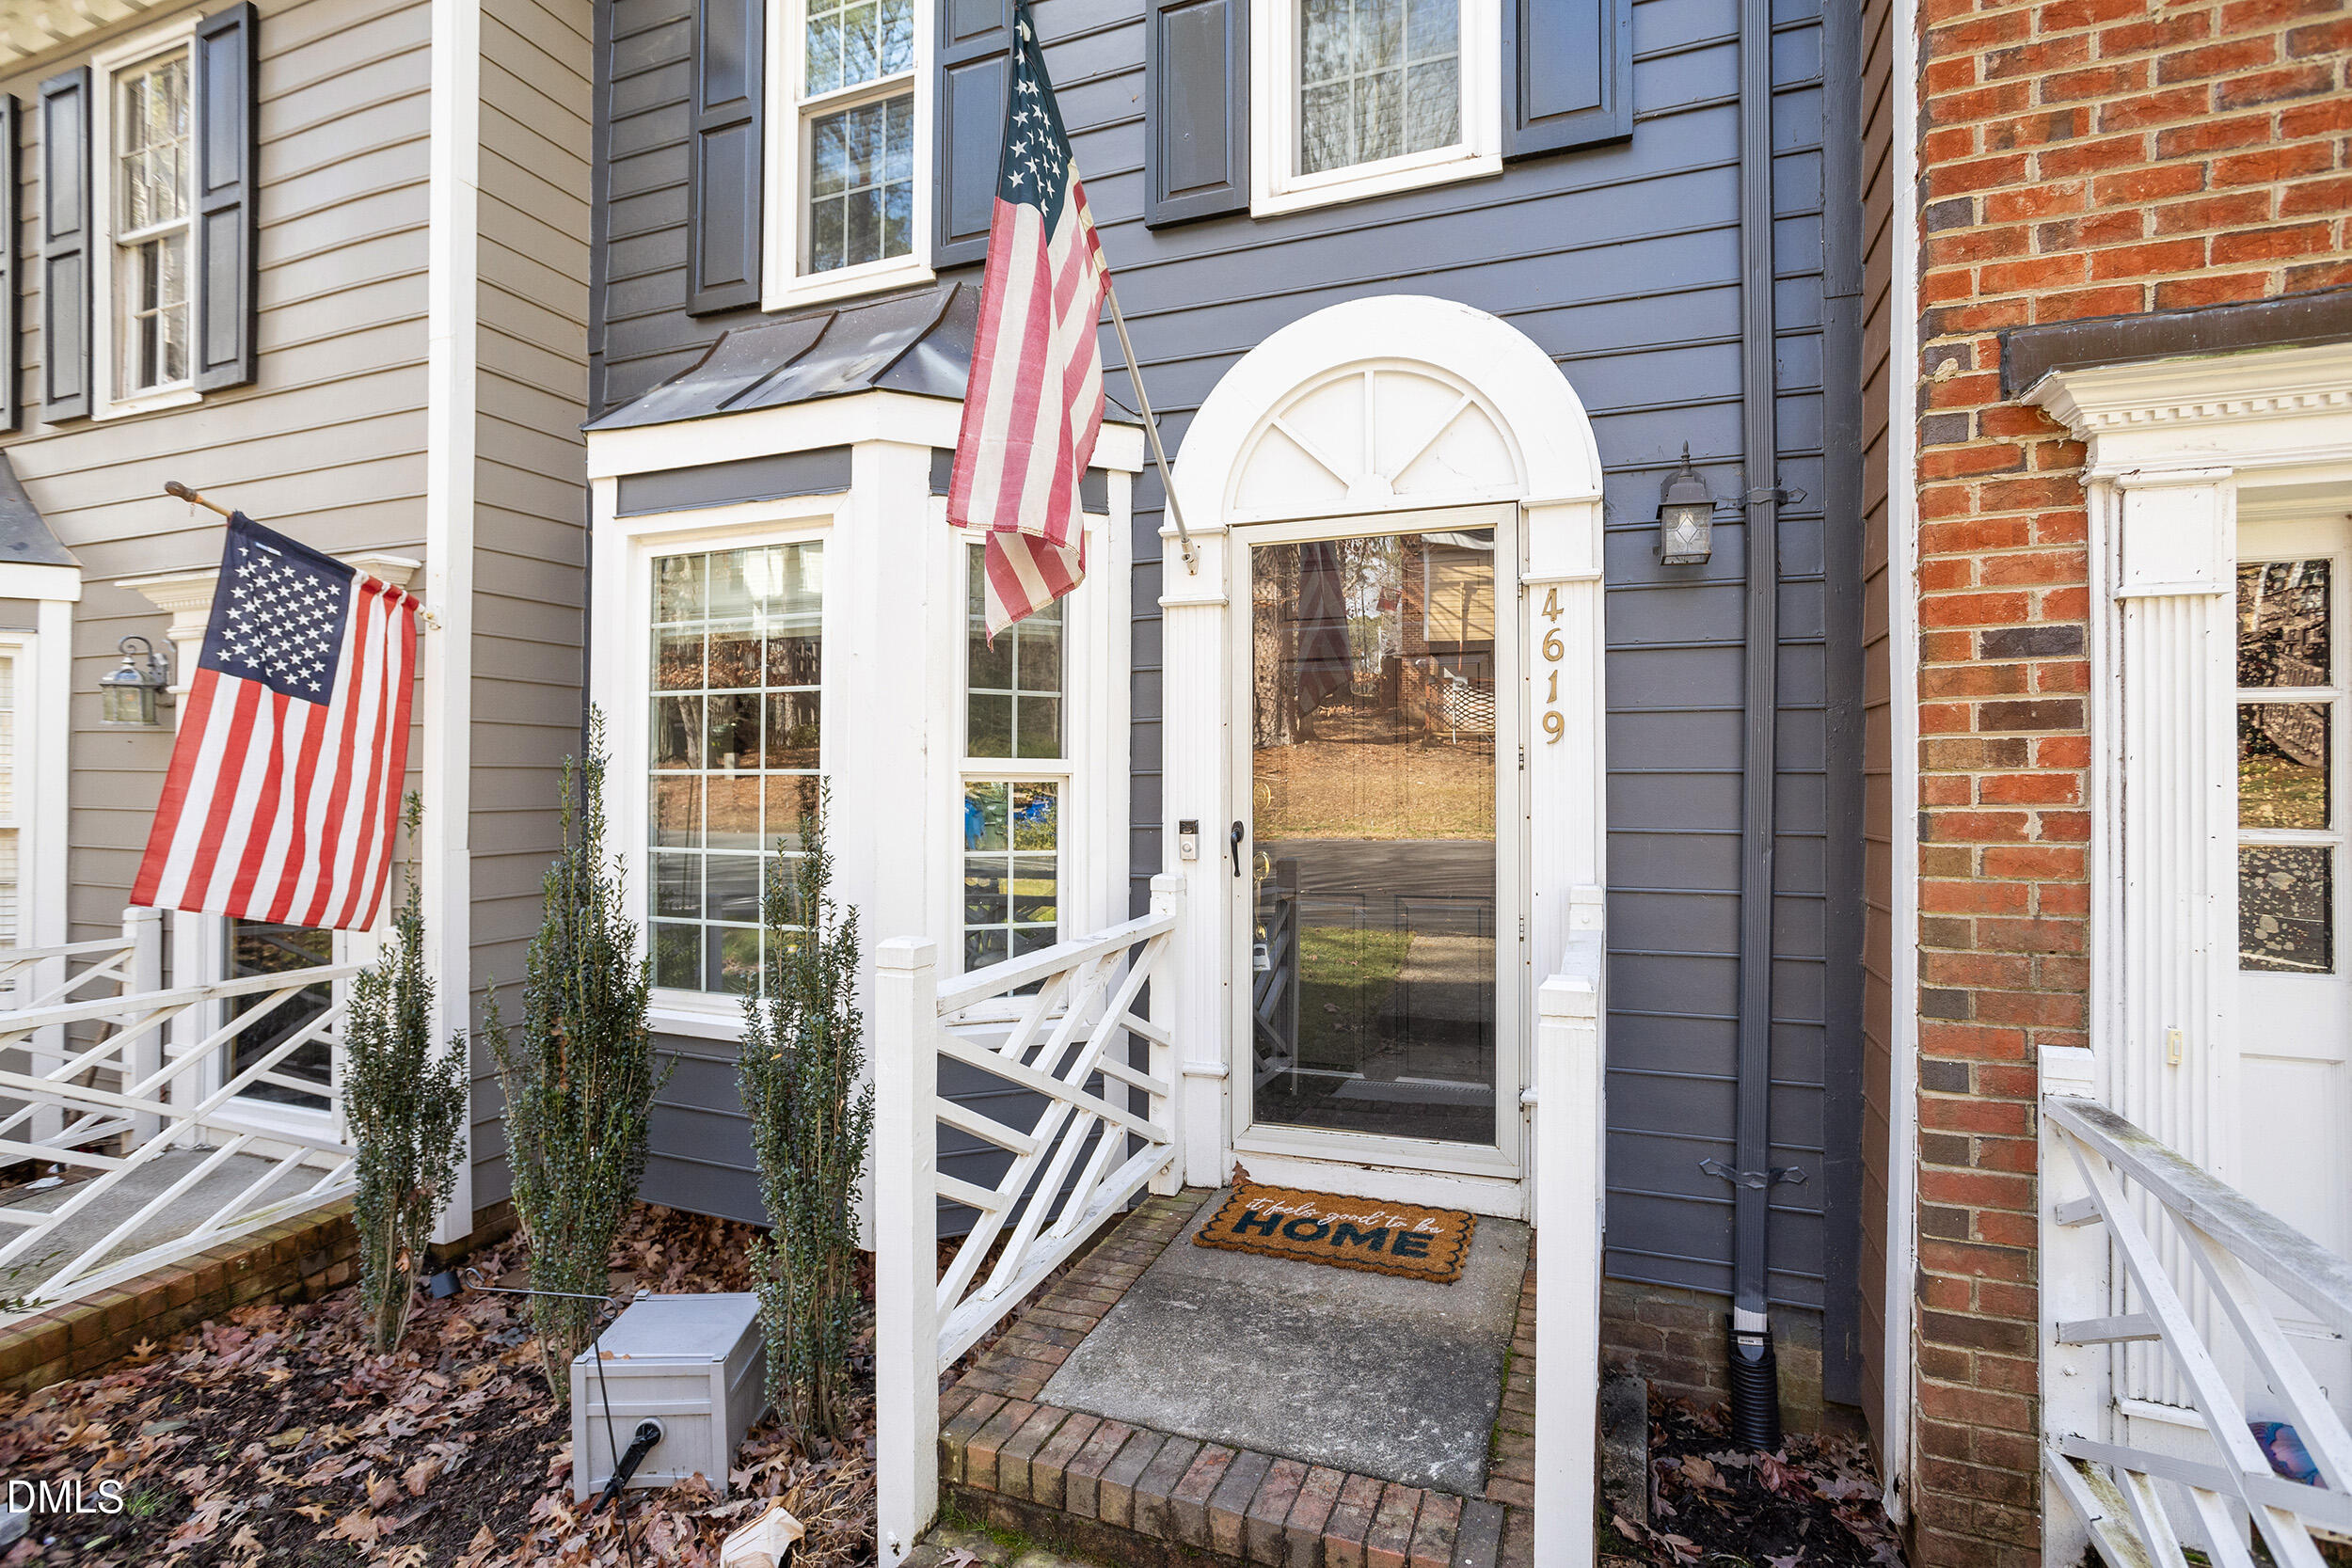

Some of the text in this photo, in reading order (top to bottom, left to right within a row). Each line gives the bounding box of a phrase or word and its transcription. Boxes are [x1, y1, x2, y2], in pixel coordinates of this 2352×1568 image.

[1541, 587, 1565, 745] 4619
[1231, 1211, 1434, 1259] HOME
[1245, 1197, 1444, 1235] it feels good to be
